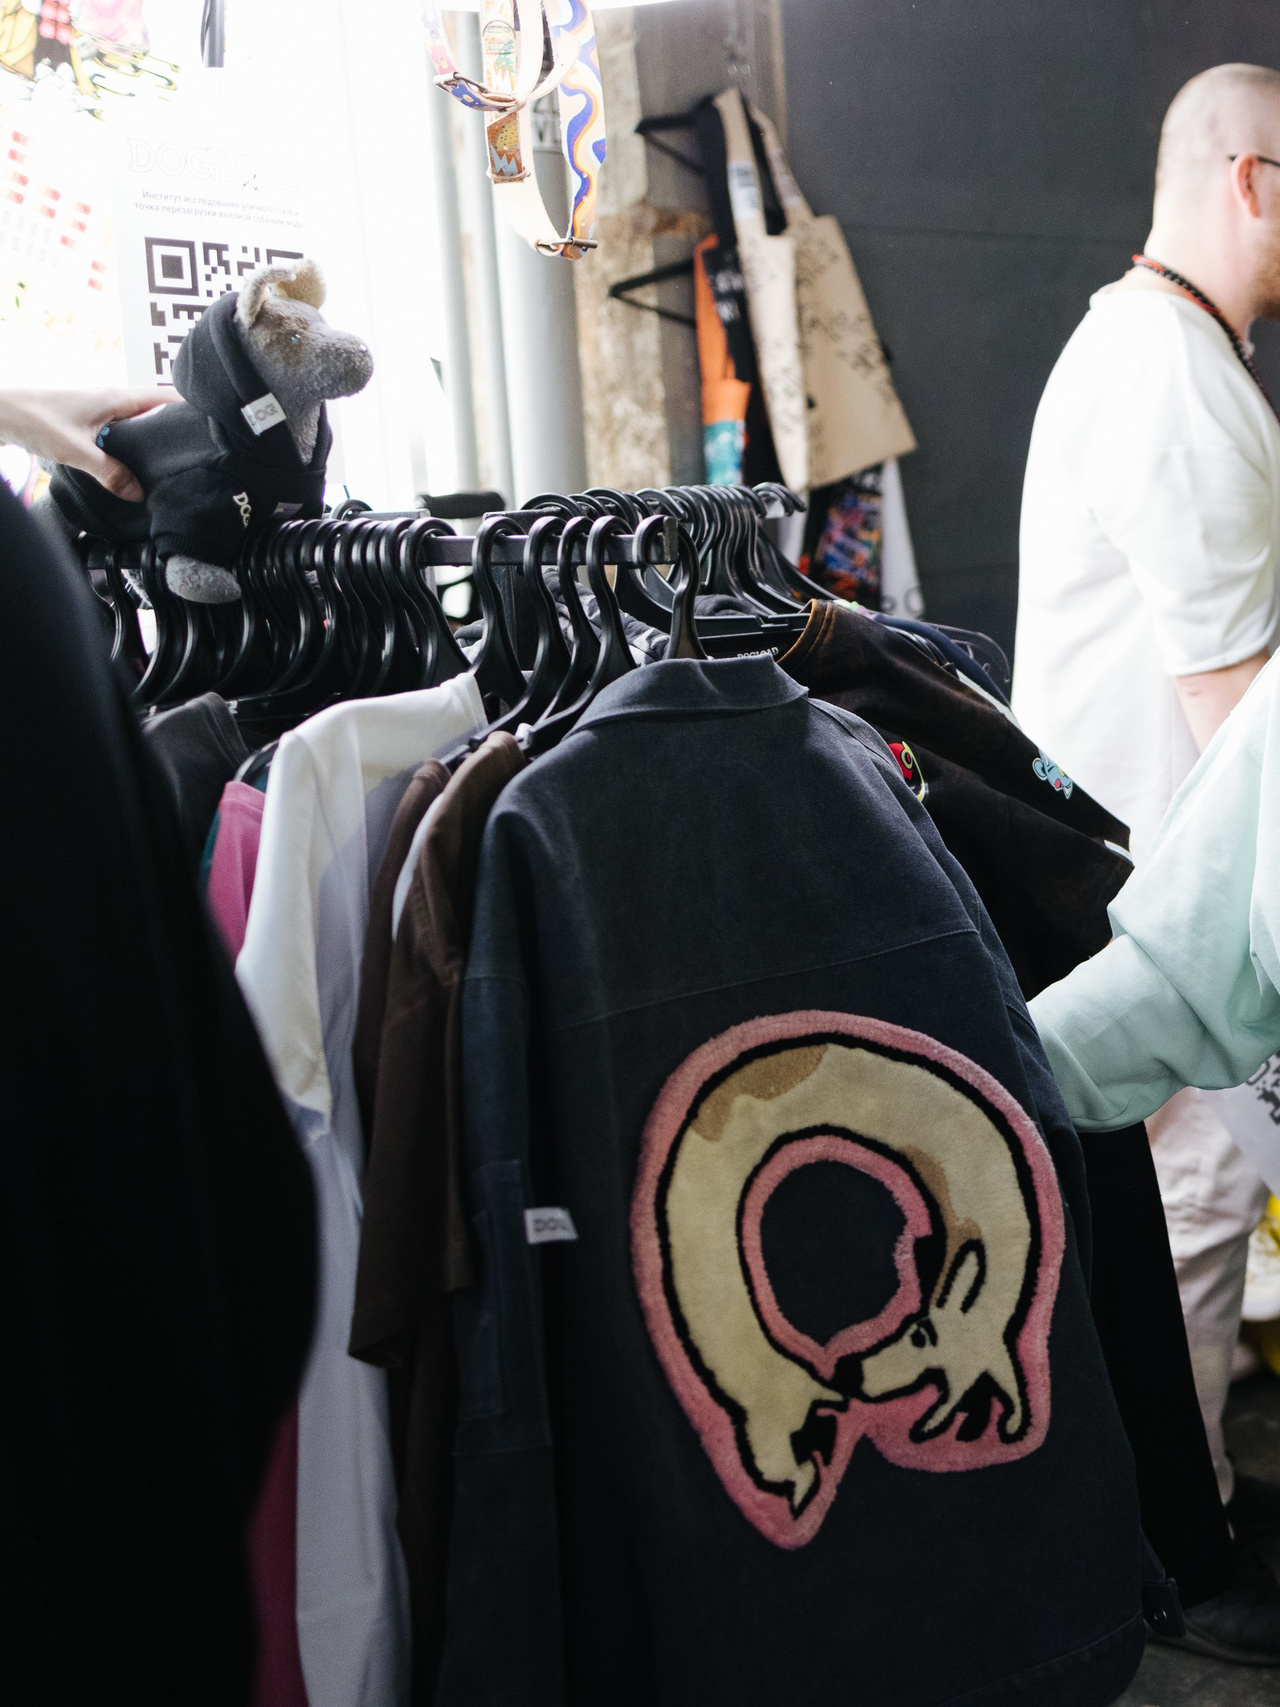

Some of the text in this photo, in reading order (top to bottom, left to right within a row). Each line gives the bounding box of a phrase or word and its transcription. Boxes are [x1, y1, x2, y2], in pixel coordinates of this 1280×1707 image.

[142, 190, 181, 204] Институт
[184, 196, 240, 208] исследования
[134, 202, 160, 212] точка
[161, 205, 217, 218] перезагрузки
